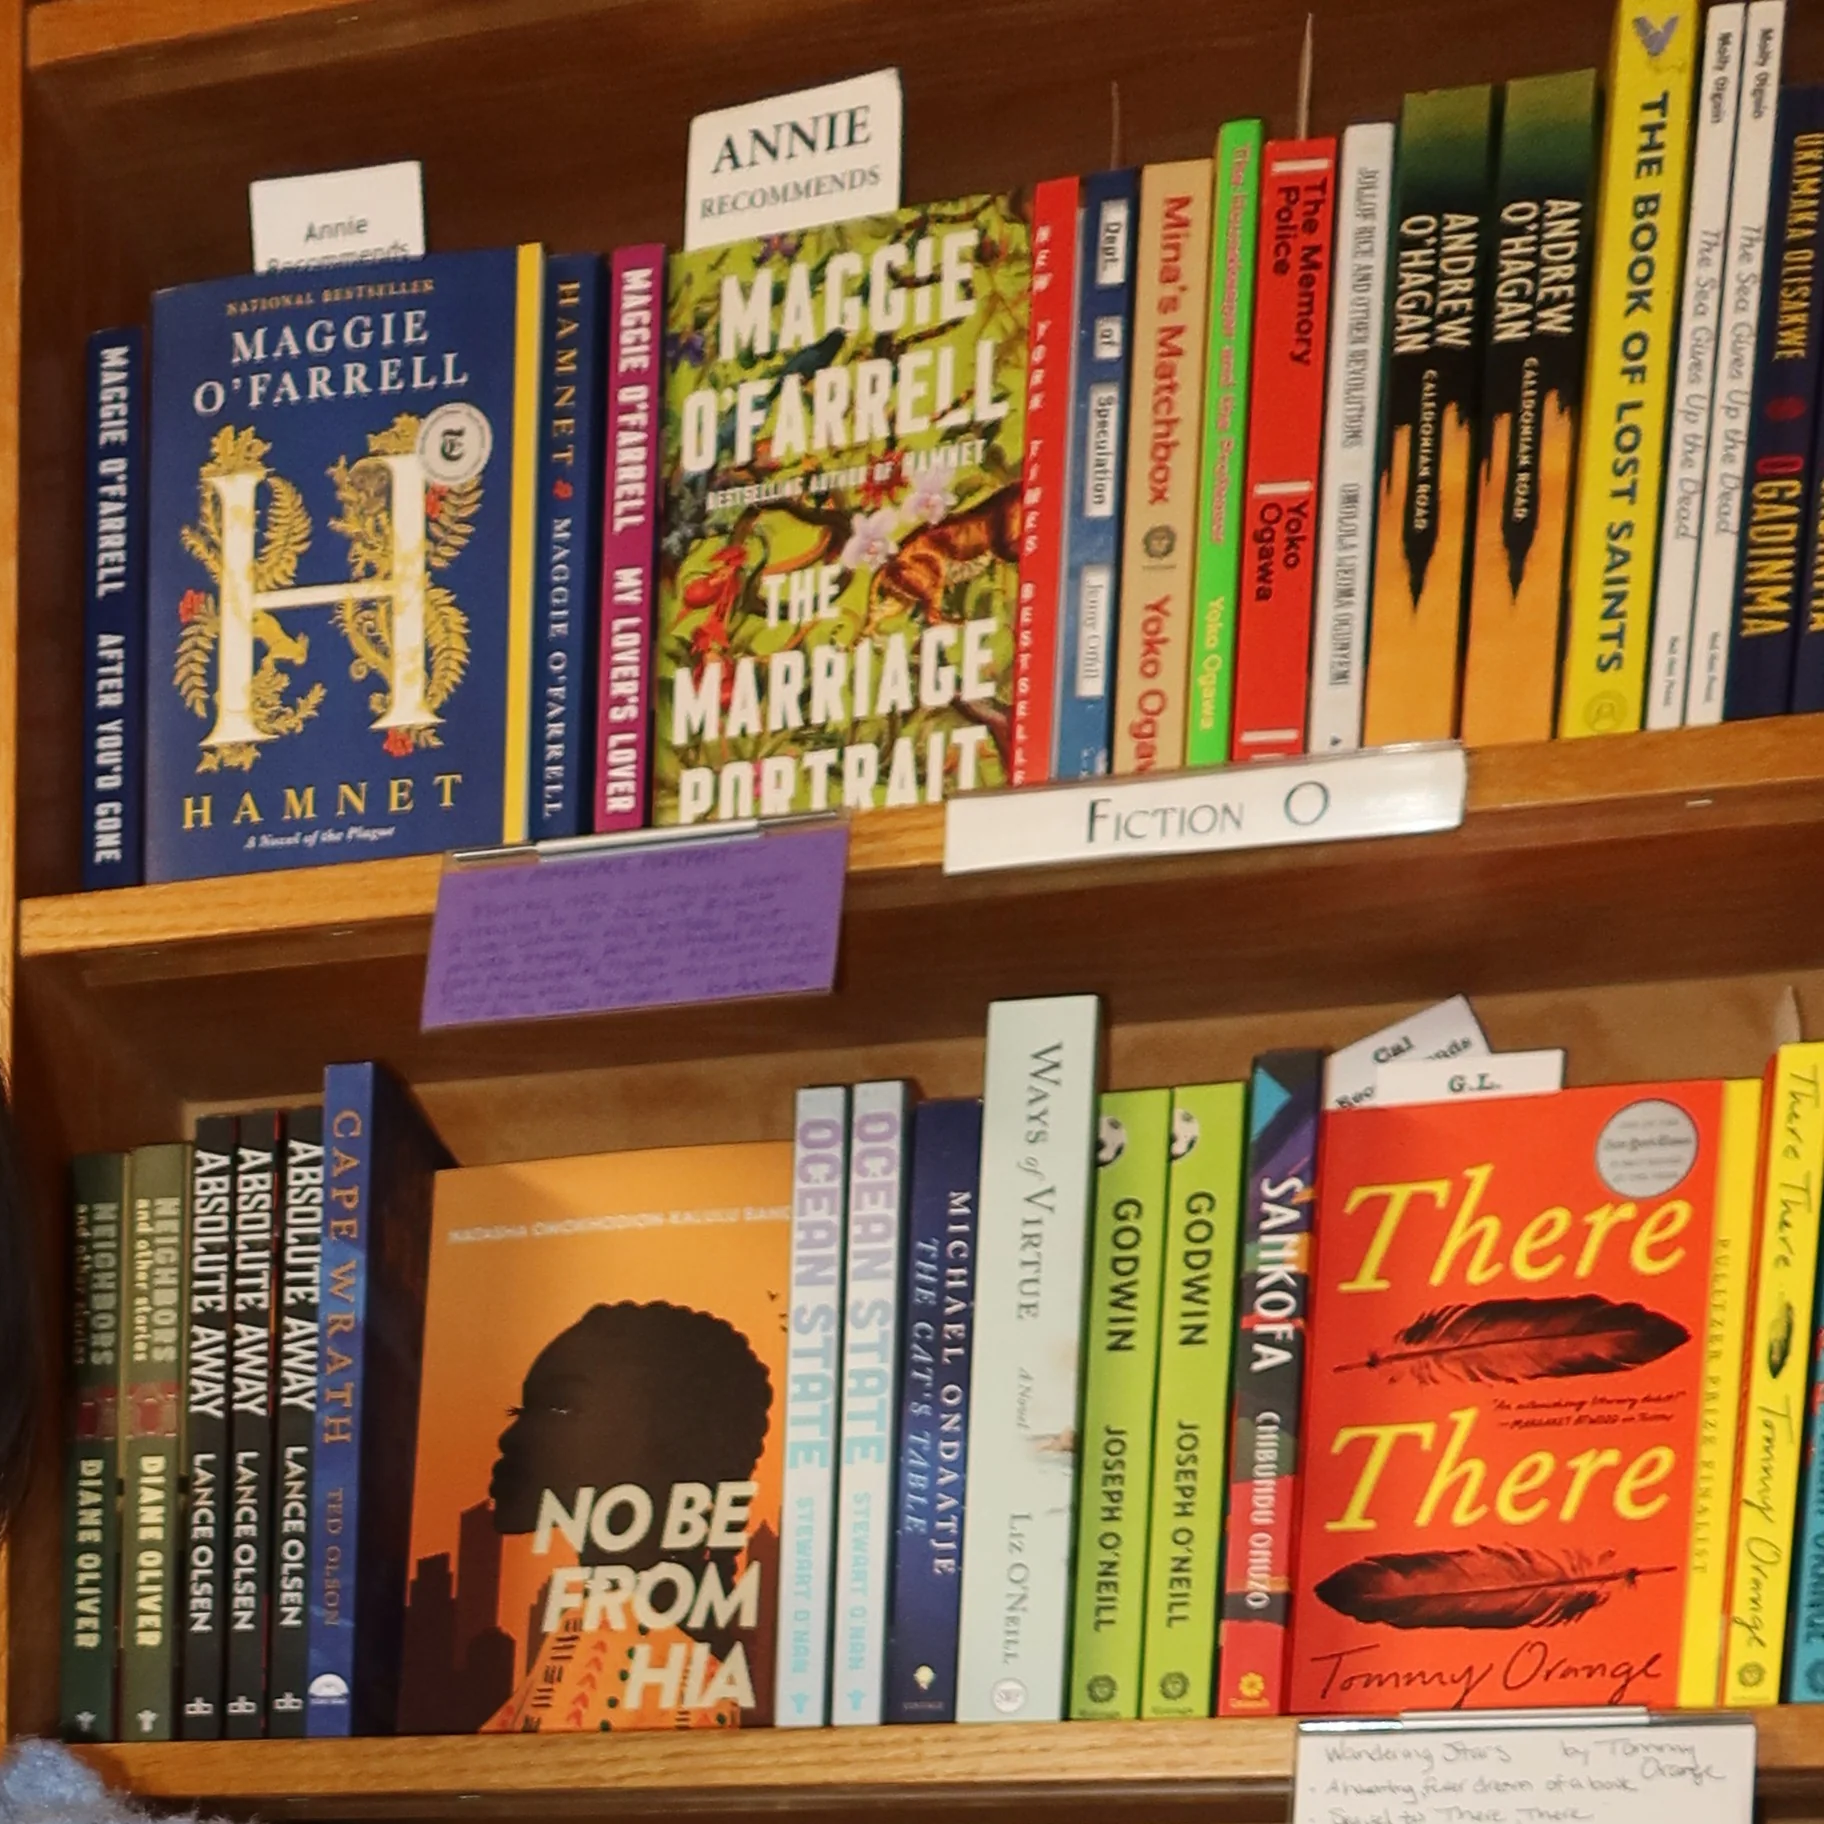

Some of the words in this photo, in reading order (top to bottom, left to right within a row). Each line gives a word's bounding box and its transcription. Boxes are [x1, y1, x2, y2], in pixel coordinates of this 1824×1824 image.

[711, 106, 873, 175] ANNIE
[1634, 92, 1669, 181] THE
[303, 212, 369, 244] Annie
[700, 163, 882, 221] RECOMMENDS
[1272, 185, 1300, 276] Police
[1304, 176, 1328, 236] The
[718, 229, 980, 361] MAGGIE
[1159, 195, 1192, 311] Mina's
[1493, 202, 1539, 344] O'HAGAN
[1535, 199, 1582, 336] ANDREW
[1622, 199, 1661, 317] BOOK
[231, 309, 431, 366] MAGGIE
[619, 267, 653, 374] MAGGIE
[1289, 242, 1324, 366] Memory
[99, 345, 130, 448] MAGGIE
[192, 352, 470, 416] O'FARRELL
[1620, 328, 1648, 384] OF
[680, 340, 1009, 474] O'FARRELL
[1146, 324, 1185, 506] Matchbox
[1606, 400, 1643, 502] LOST
[613, 384, 649, 534] O'FARRELL
[95, 457, 128, 600] O'FARRELL
[1255, 502, 1282, 603] Ogawa
[1281, 502, 1309, 571] Yoko
[613, 568, 643, 605] MY
[762, 564, 842, 628] THE
[1596, 523, 1633, 673] SAINTS
[96, 632, 125, 709] AFTER
[608, 616, 642, 724] LOVER'S
[671, 618, 998, 746] MARRIAGE
[1139, 595, 1172, 679] Yoko
[94, 718, 124, 791] YOU'D
[182, 774, 463, 830] HAMNET
[606, 731, 638, 816] LOVER
[678, 725, 988, 824] PORTRAIT
[94, 799, 122, 865] GONE
[259, 830, 300, 850] Novel
[304, 826, 317, 846] of
[321, 826, 345, 845] the
[348, 824, 396, 846] Plague
[1088, 797, 1245, 844] FICTION
[1283, 779, 1330, 826] O
[1447, 1072, 1502, 1094] G.L.
[284, 1138, 324, 1306] ABSOLUTE
[328, 1106, 362, 1242] CAPE
[796, 1117, 842, 1289] OCEAN
[1102, 1195, 1143, 1355] GODWIN
[1247, 1176, 1304, 1374] SANKOFA
[1337, 1162, 1694, 1295] There
[280, 1314, 319, 1413] AWAY
[322, 1258, 359, 1445] WRATH
[787, 1304, 834, 1472] STATE
[282, 1444, 310, 1534] LANCE
[531, 1485, 654, 1556] NO
[658, 1480, 760, 1551] BE
[1325, 1407, 1679, 1536] There
[279, 1538, 306, 1629] OLSEN
[540, 1561, 763, 1636] FROM
[622, 1641, 757, 1712] HIA
[1310, 1642, 1498, 1709] Tommy
[1501, 1640, 1666, 1703] Orange
